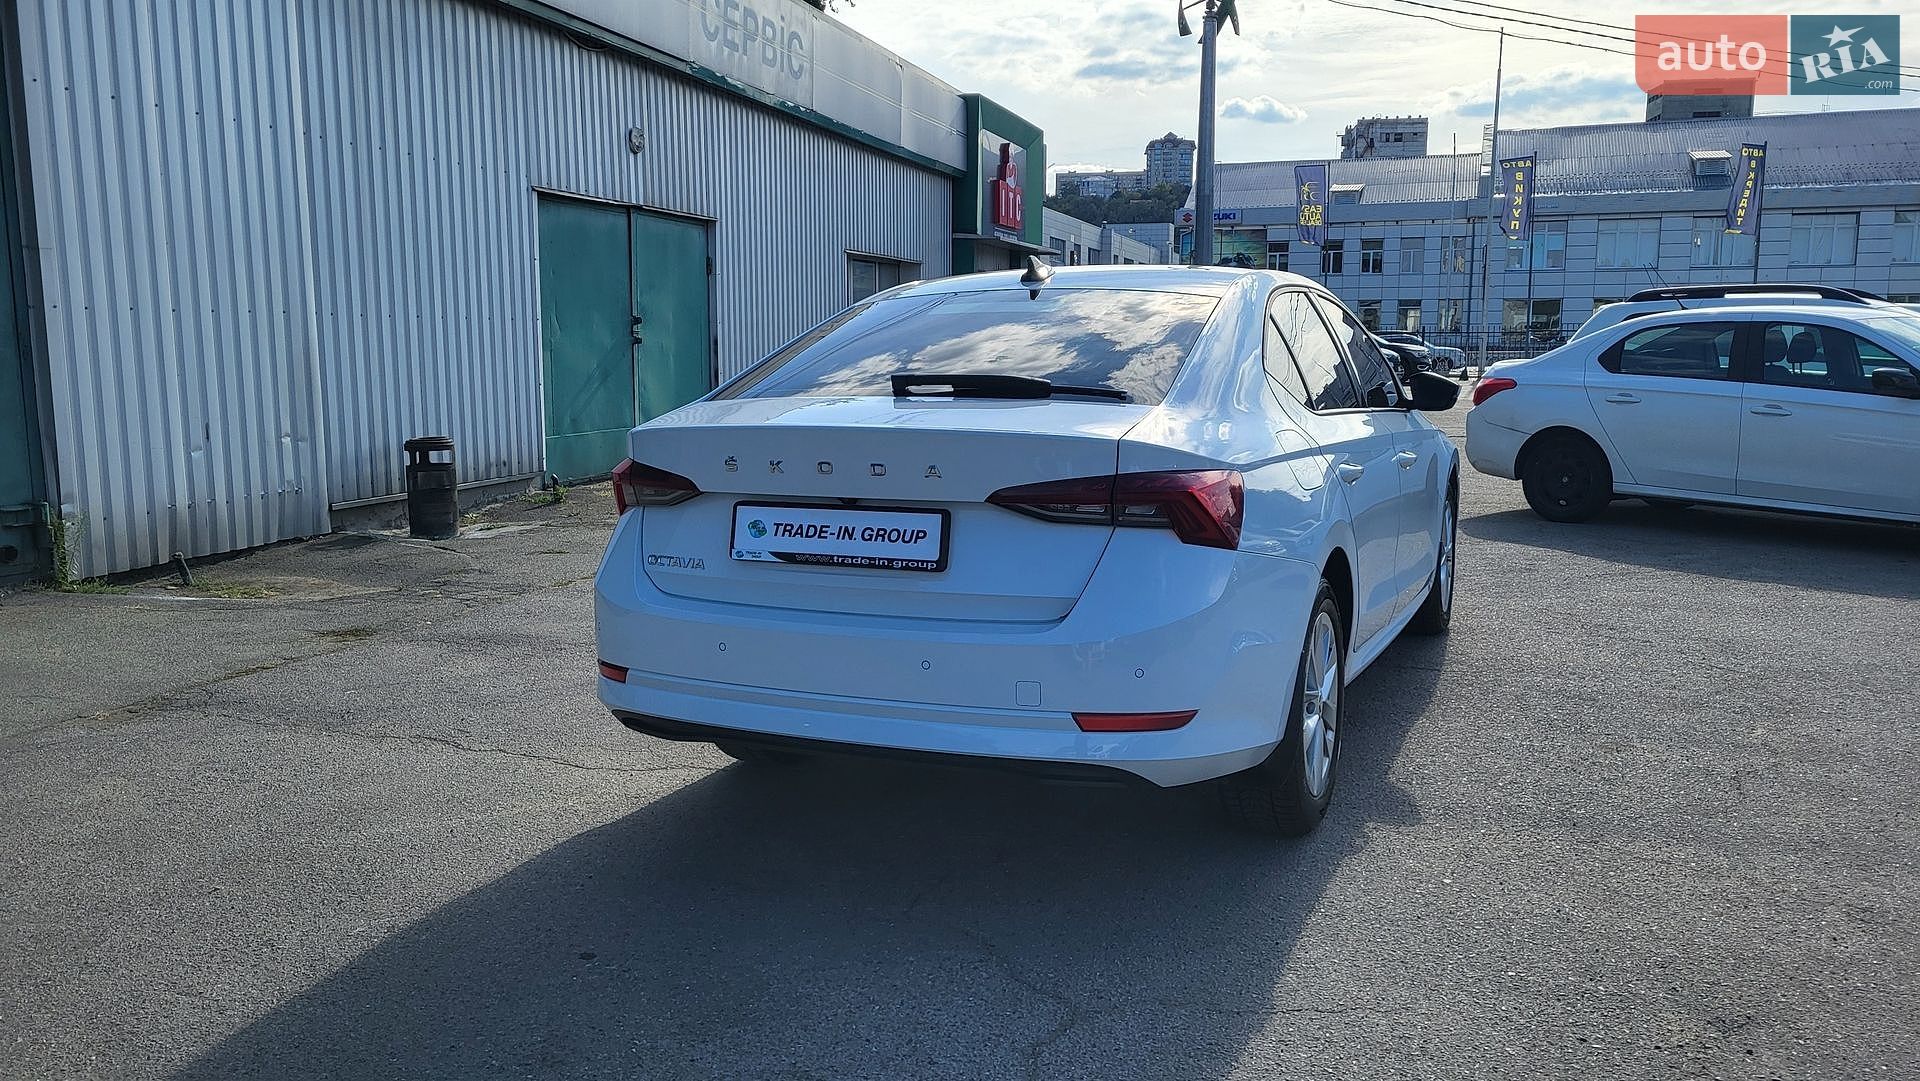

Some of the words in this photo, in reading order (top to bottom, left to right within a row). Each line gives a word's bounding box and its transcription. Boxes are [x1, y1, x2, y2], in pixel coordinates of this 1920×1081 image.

[725, 456, 943, 478] ŠKODA
[860, 526, 928, 544] GROUP
[648, 554, 705, 570] OCTAVIA
[795, 554, 937, 570] www.trade-in.group
